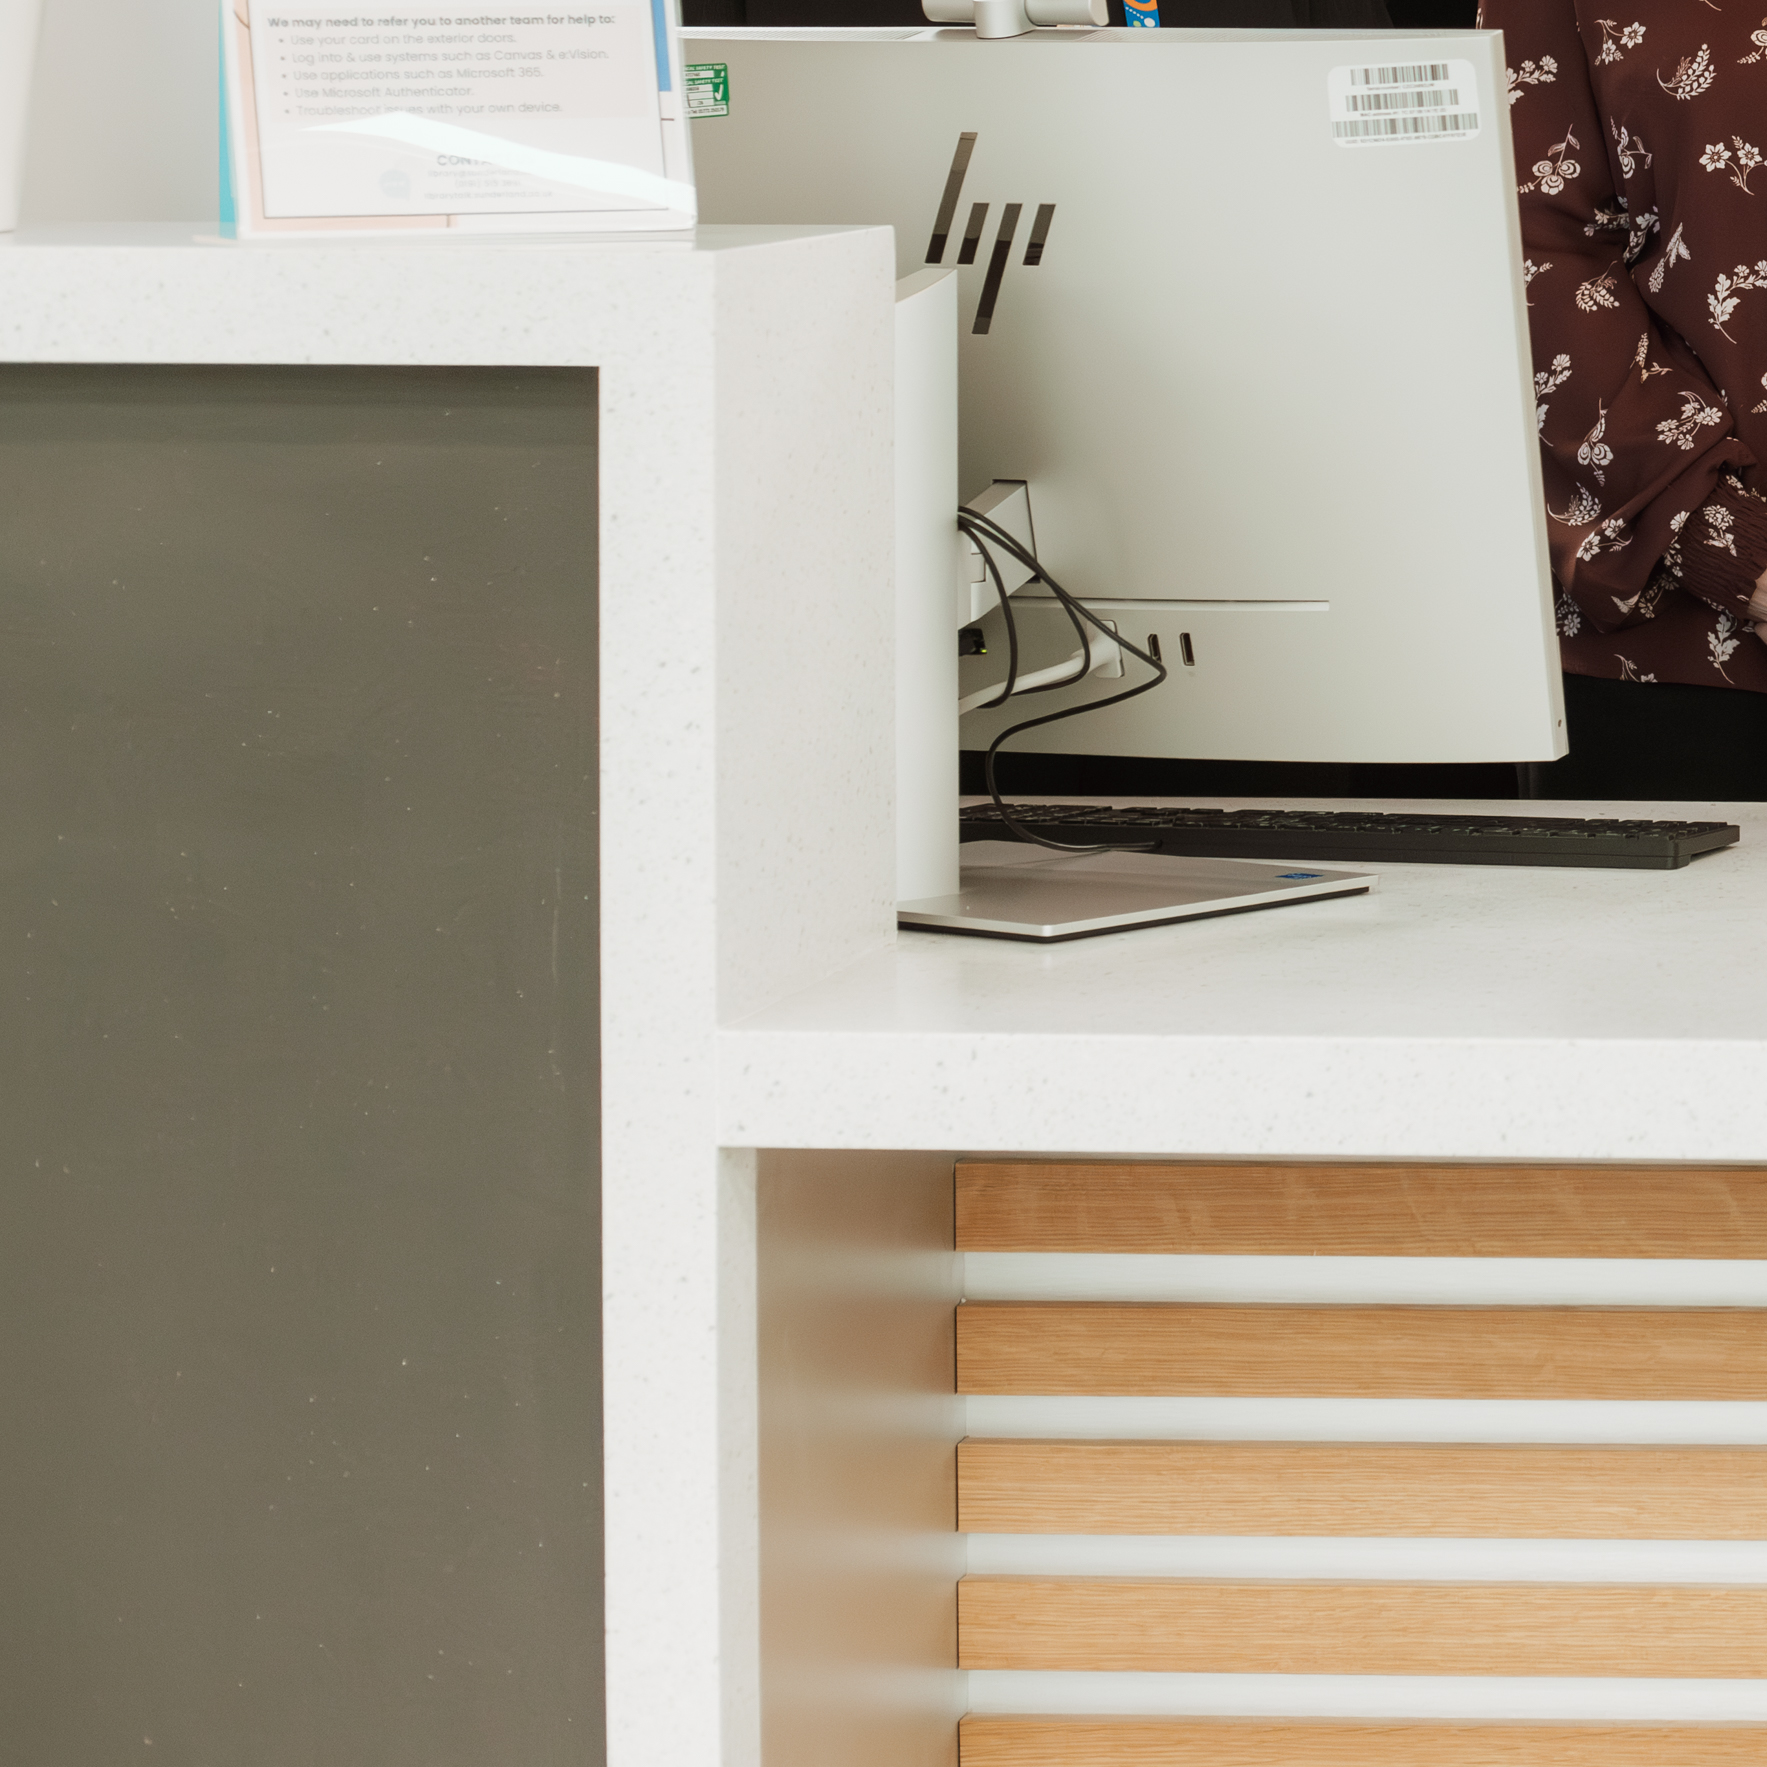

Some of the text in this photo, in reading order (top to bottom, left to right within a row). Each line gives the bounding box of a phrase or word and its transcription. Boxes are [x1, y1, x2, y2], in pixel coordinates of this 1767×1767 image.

[268, 14, 615, 30] We may need to refer you to another team for help to:
[293, 70, 318, 81] Use
[321, 68, 400, 83] applications
[404, 69, 434, 80] such
[457, 67, 515, 79] Microsoft
[518, 67, 543, 78] 365.
